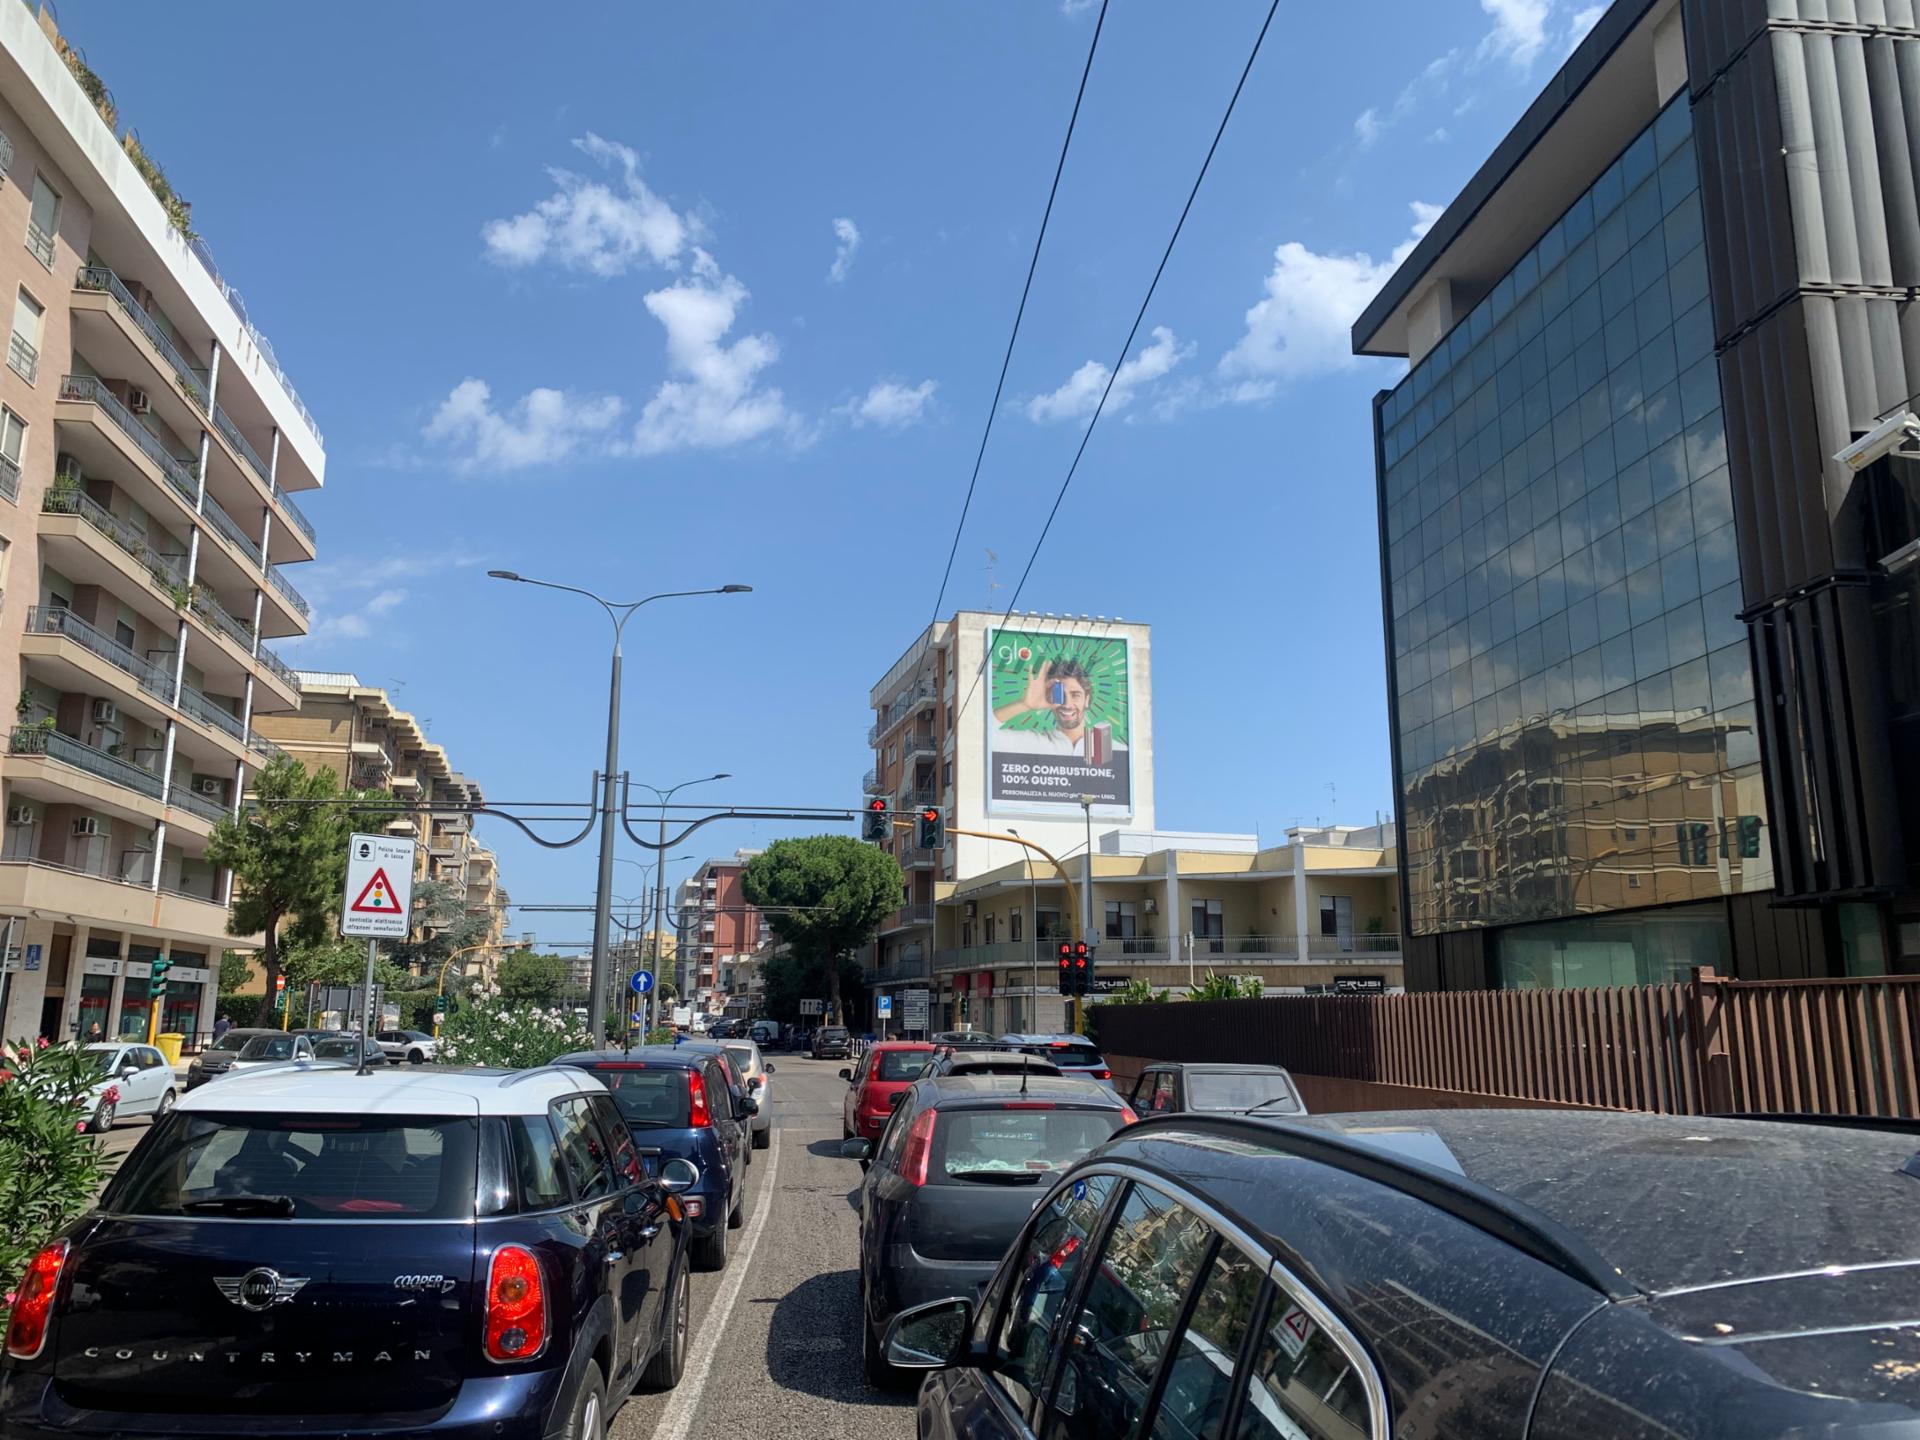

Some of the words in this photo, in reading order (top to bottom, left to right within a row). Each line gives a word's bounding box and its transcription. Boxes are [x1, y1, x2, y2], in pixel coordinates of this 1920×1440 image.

[999, 639, 1032, 665] glo
[1001, 763, 1030, 774] ZERO
[1032, 765, 1115, 779] COMBUSTIONE,
[1002, 775, 1029, 785] 100%
[1031, 776, 1071, 787] GUSTO.
[1337, 980, 1381, 990] CRUSI
[882, 998, 889, 1008] P
[393, 1275, 443, 1288] COOPER
[244, 1283, 274, 1295] MINI
[84, 1346, 431, 1363] COUNTRYMAN
